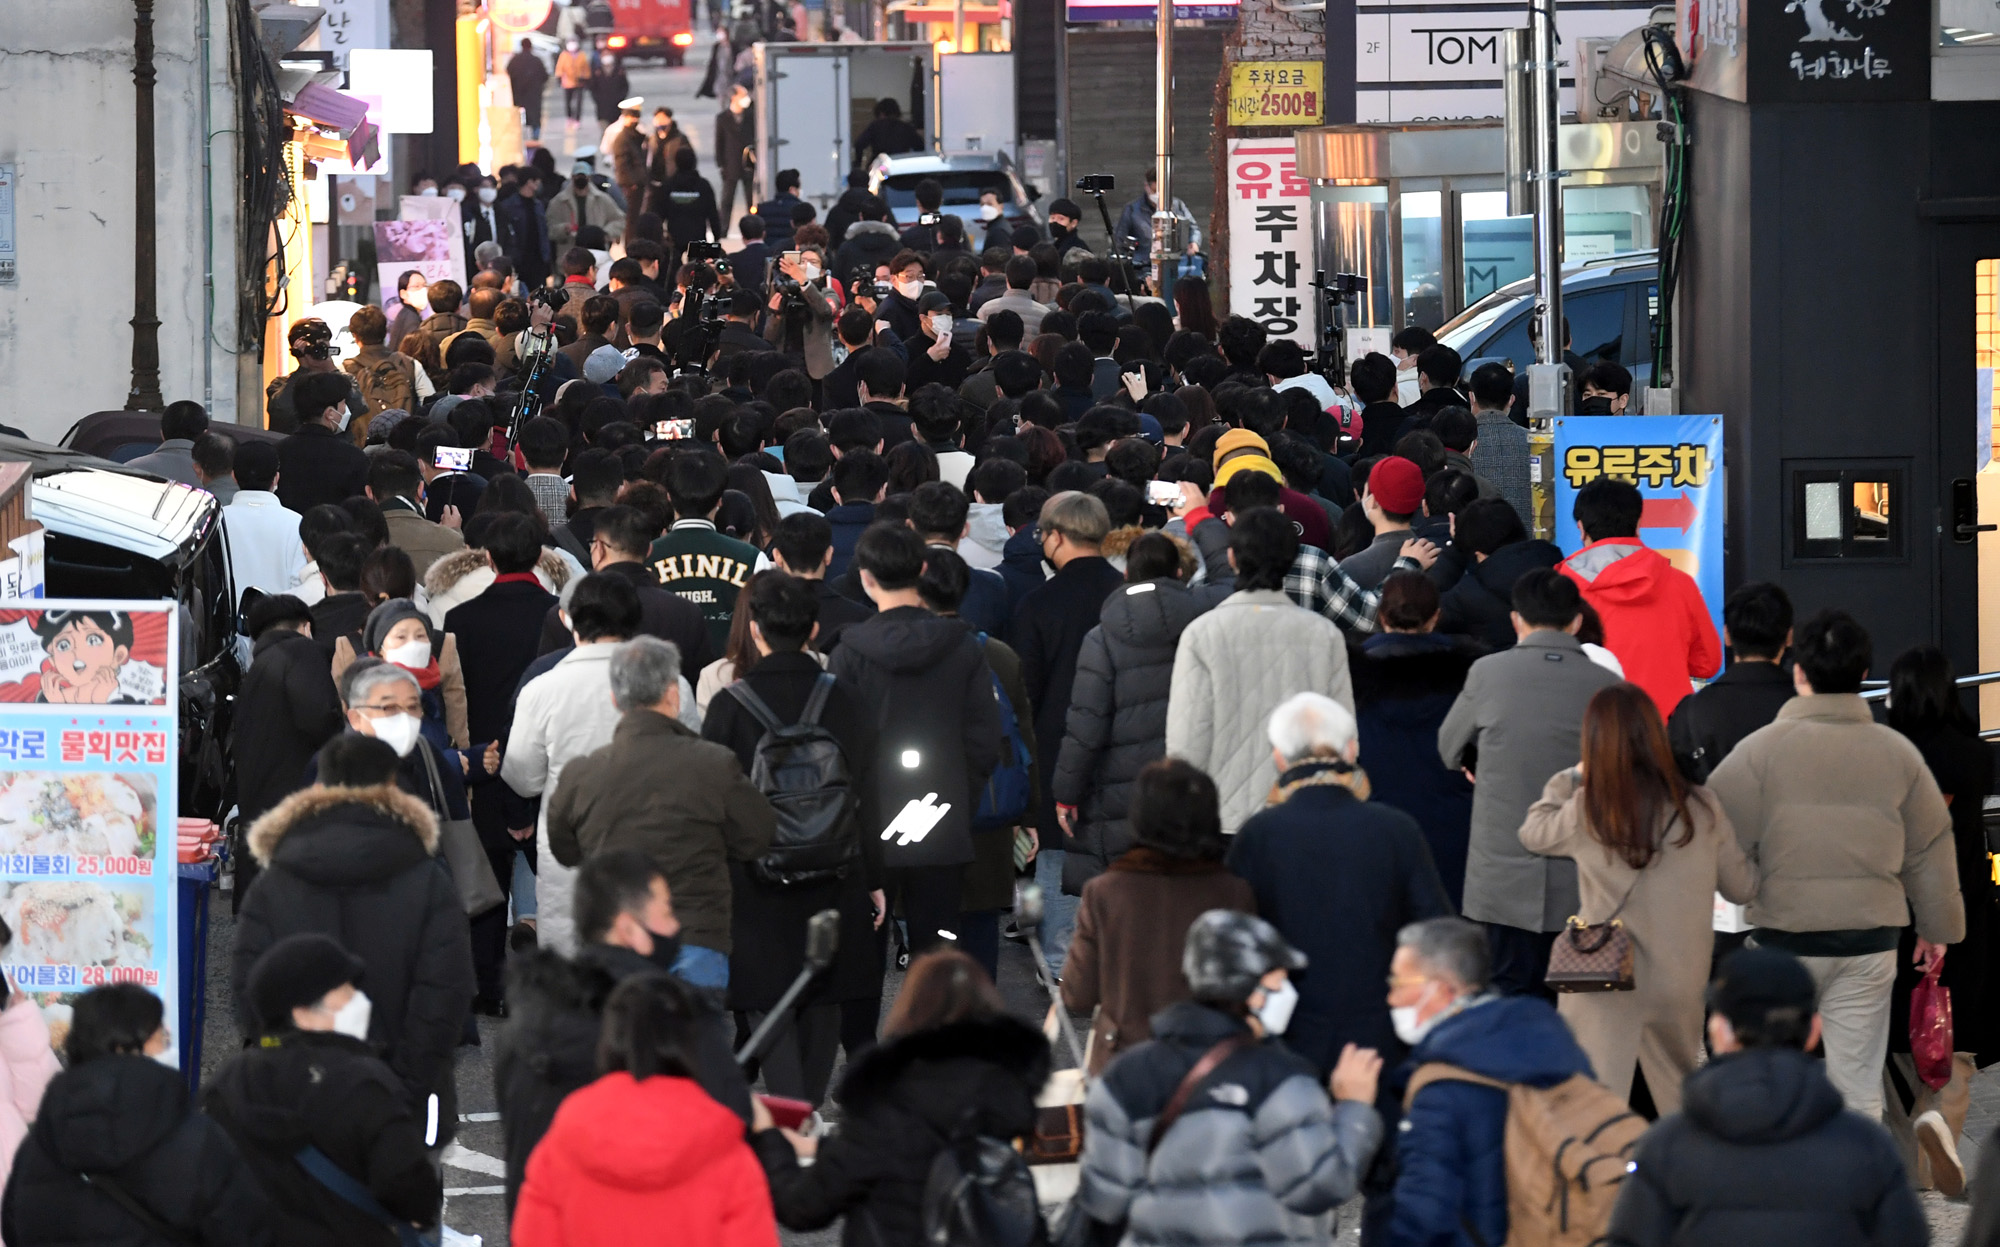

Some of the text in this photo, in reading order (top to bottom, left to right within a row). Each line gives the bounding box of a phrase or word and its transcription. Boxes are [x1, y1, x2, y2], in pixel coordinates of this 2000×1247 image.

[1366, 42, 1381, 54] 2F
[1789, 46, 1892, 80] 혜화나무
[1248, 69, 1305, 86] 주차요금
[1261, 91, 1317, 117] 2500원
[1236, 161, 1311, 199] 유료
[1252, 204, 1302, 336] 주차장
[1564, 443, 1715, 490] 유료주차
[645, 553, 749, 589] HINIL
[0, 730, 166, 763] 학로 물회맛집
[76, 856, 152, 876] 25,000원
